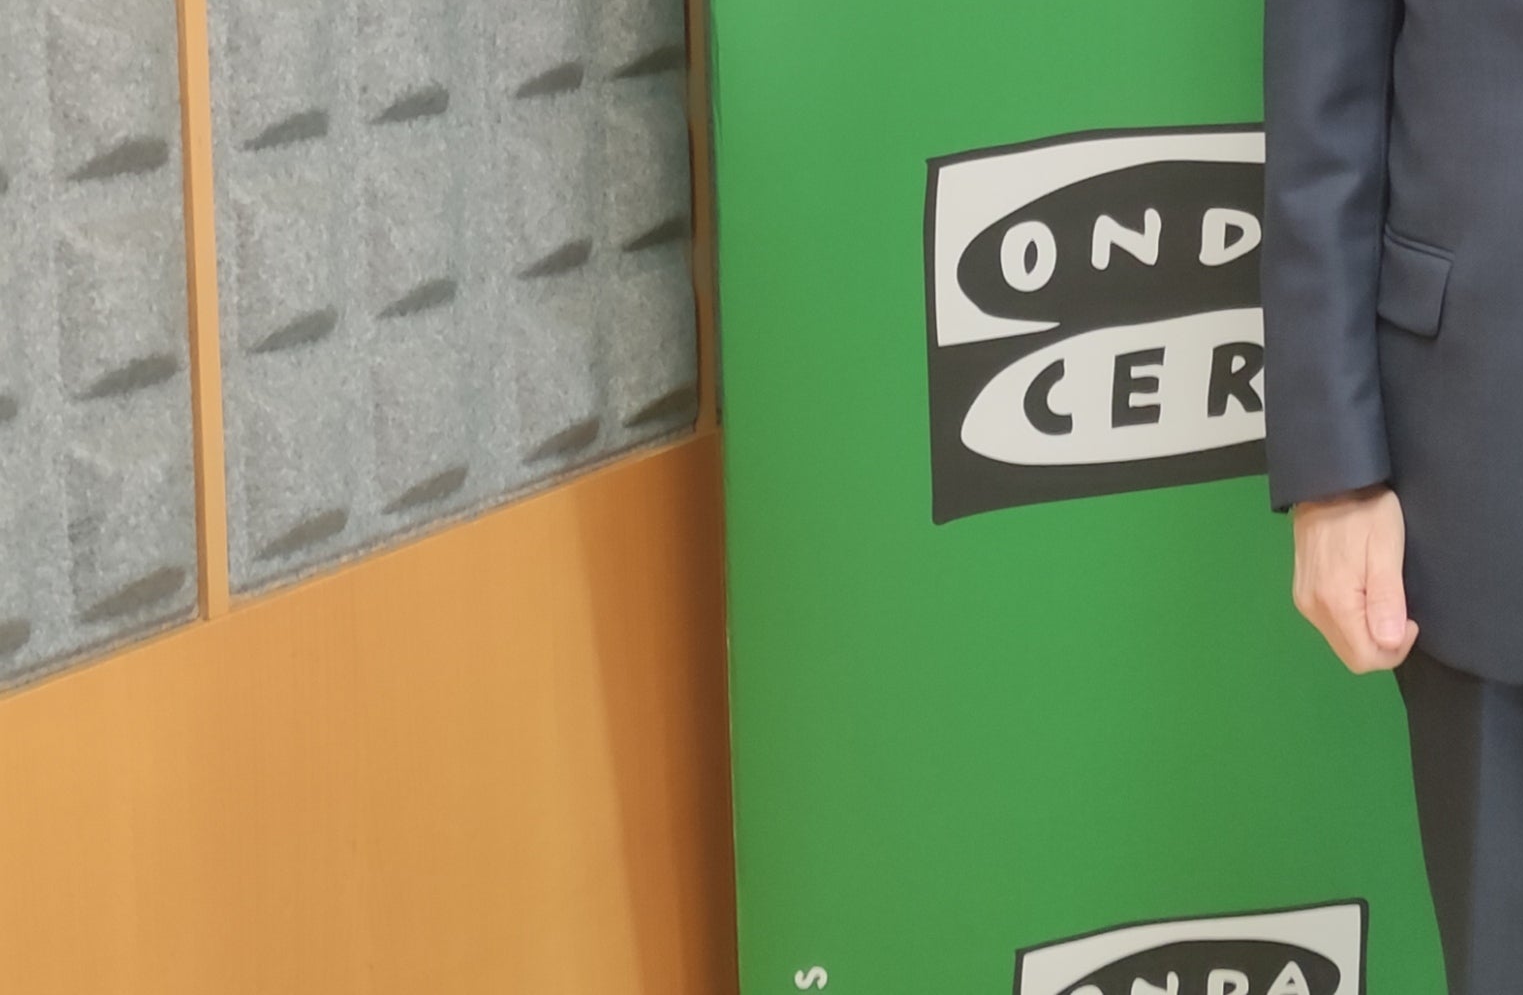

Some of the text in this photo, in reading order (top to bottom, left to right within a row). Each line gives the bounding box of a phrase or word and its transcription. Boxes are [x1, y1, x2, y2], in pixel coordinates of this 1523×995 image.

[1000, 208, 1262, 292] OND
[1023, 341, 1265, 436] CER
[1069, 960, 1311, 995] NDA
